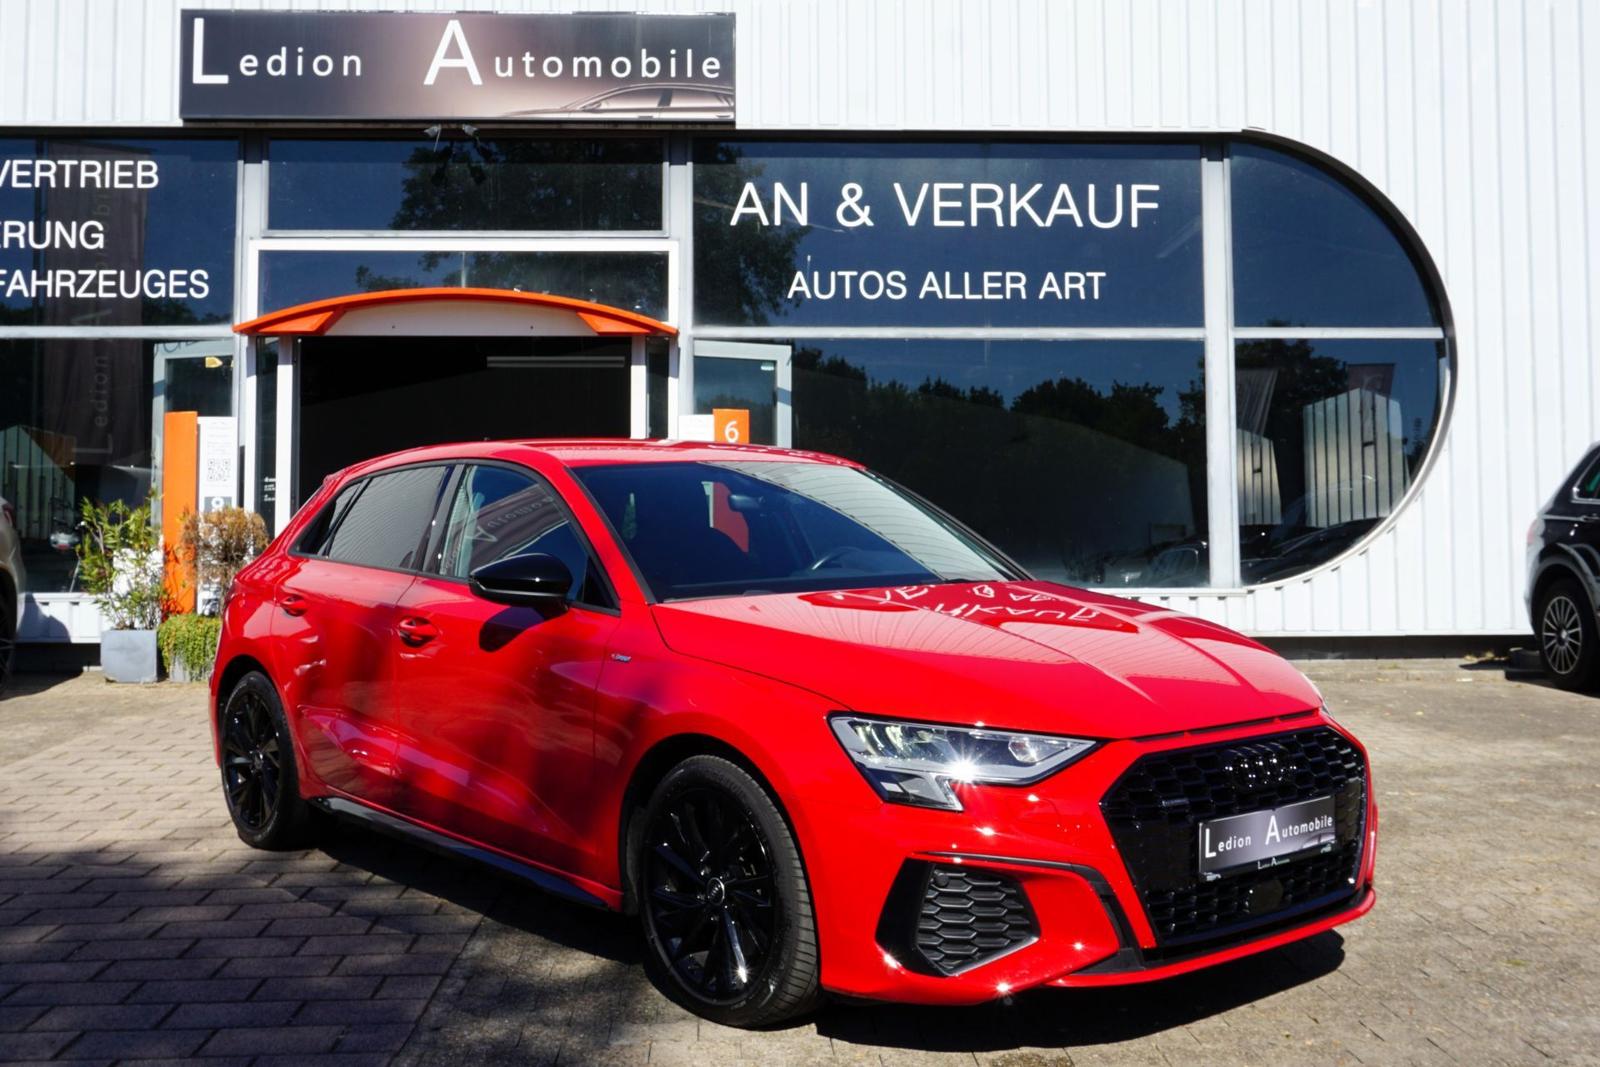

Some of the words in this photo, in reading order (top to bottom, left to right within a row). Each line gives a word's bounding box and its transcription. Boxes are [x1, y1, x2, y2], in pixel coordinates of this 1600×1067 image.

[192, 17, 362, 85] Ledion
[423, 19, 723, 86] Automobile
[729, 181, 808, 228] AN
[835, 181, 875, 229] &
[892, 182, 1161, 230] VERKAUF
[0, 219, 105, 251] RUNG
[787, 270, 908, 301] AUTOS
[918, 270, 1027, 301] ALLER
[1038, 270, 1107, 301] ART
[724, 419, 739, 444] 6
[1204, 828, 1253, 859] Ledion
[1264, 814, 1334, 846] Automobile
